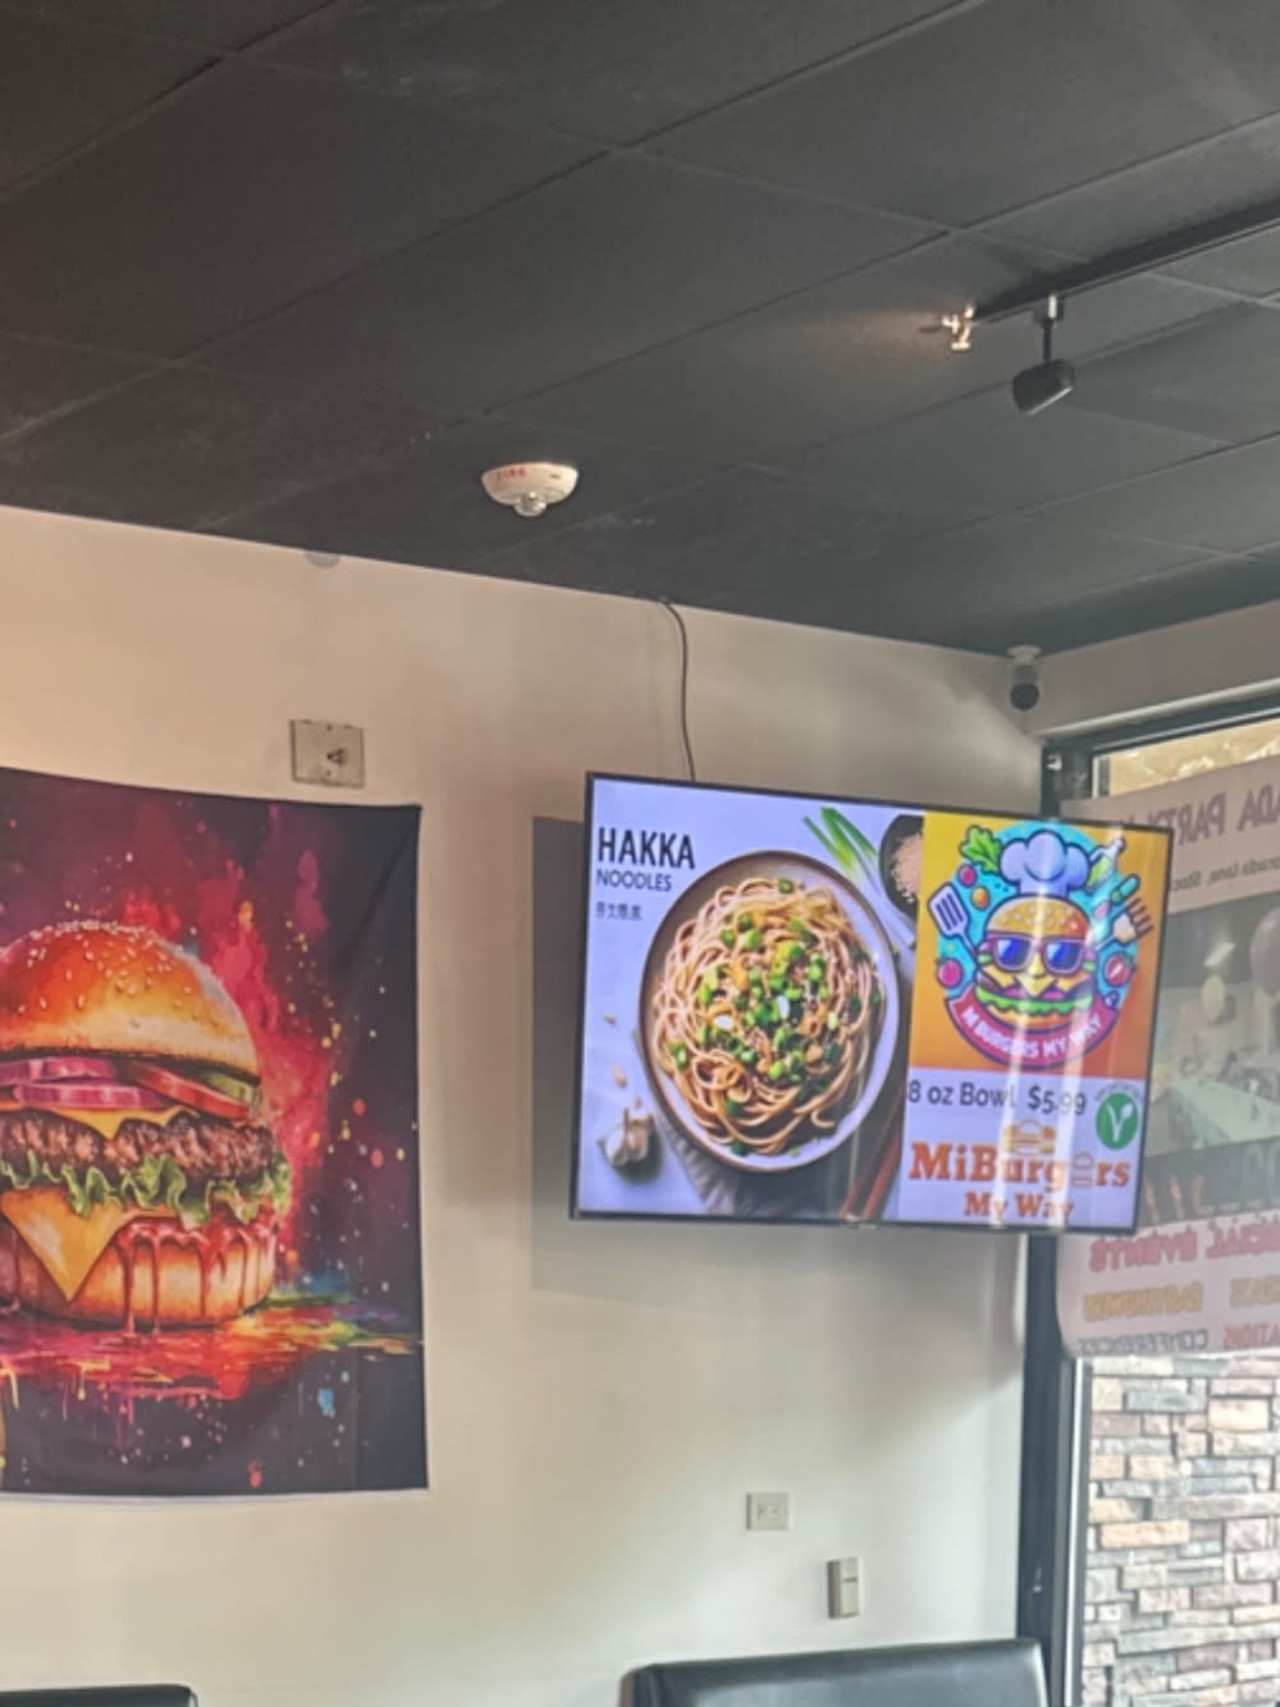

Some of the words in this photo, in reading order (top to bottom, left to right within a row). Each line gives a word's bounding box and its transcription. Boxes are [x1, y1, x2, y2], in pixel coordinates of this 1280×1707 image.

[598, 826, 696, 871] HAKKA
[596, 868, 672, 893] NOODLES
[1043, 1037, 1066, 1058] MY
[907, 1080, 922, 1103] 8
[926, 1084, 955, 1106] oz
[959, 1081, 1017, 1108] Bowl
[1027, 1084, 1087, 1116] $5.99
[963, 1190, 1008, 1226] My
[1013, 1191, 1074, 1222] Way
